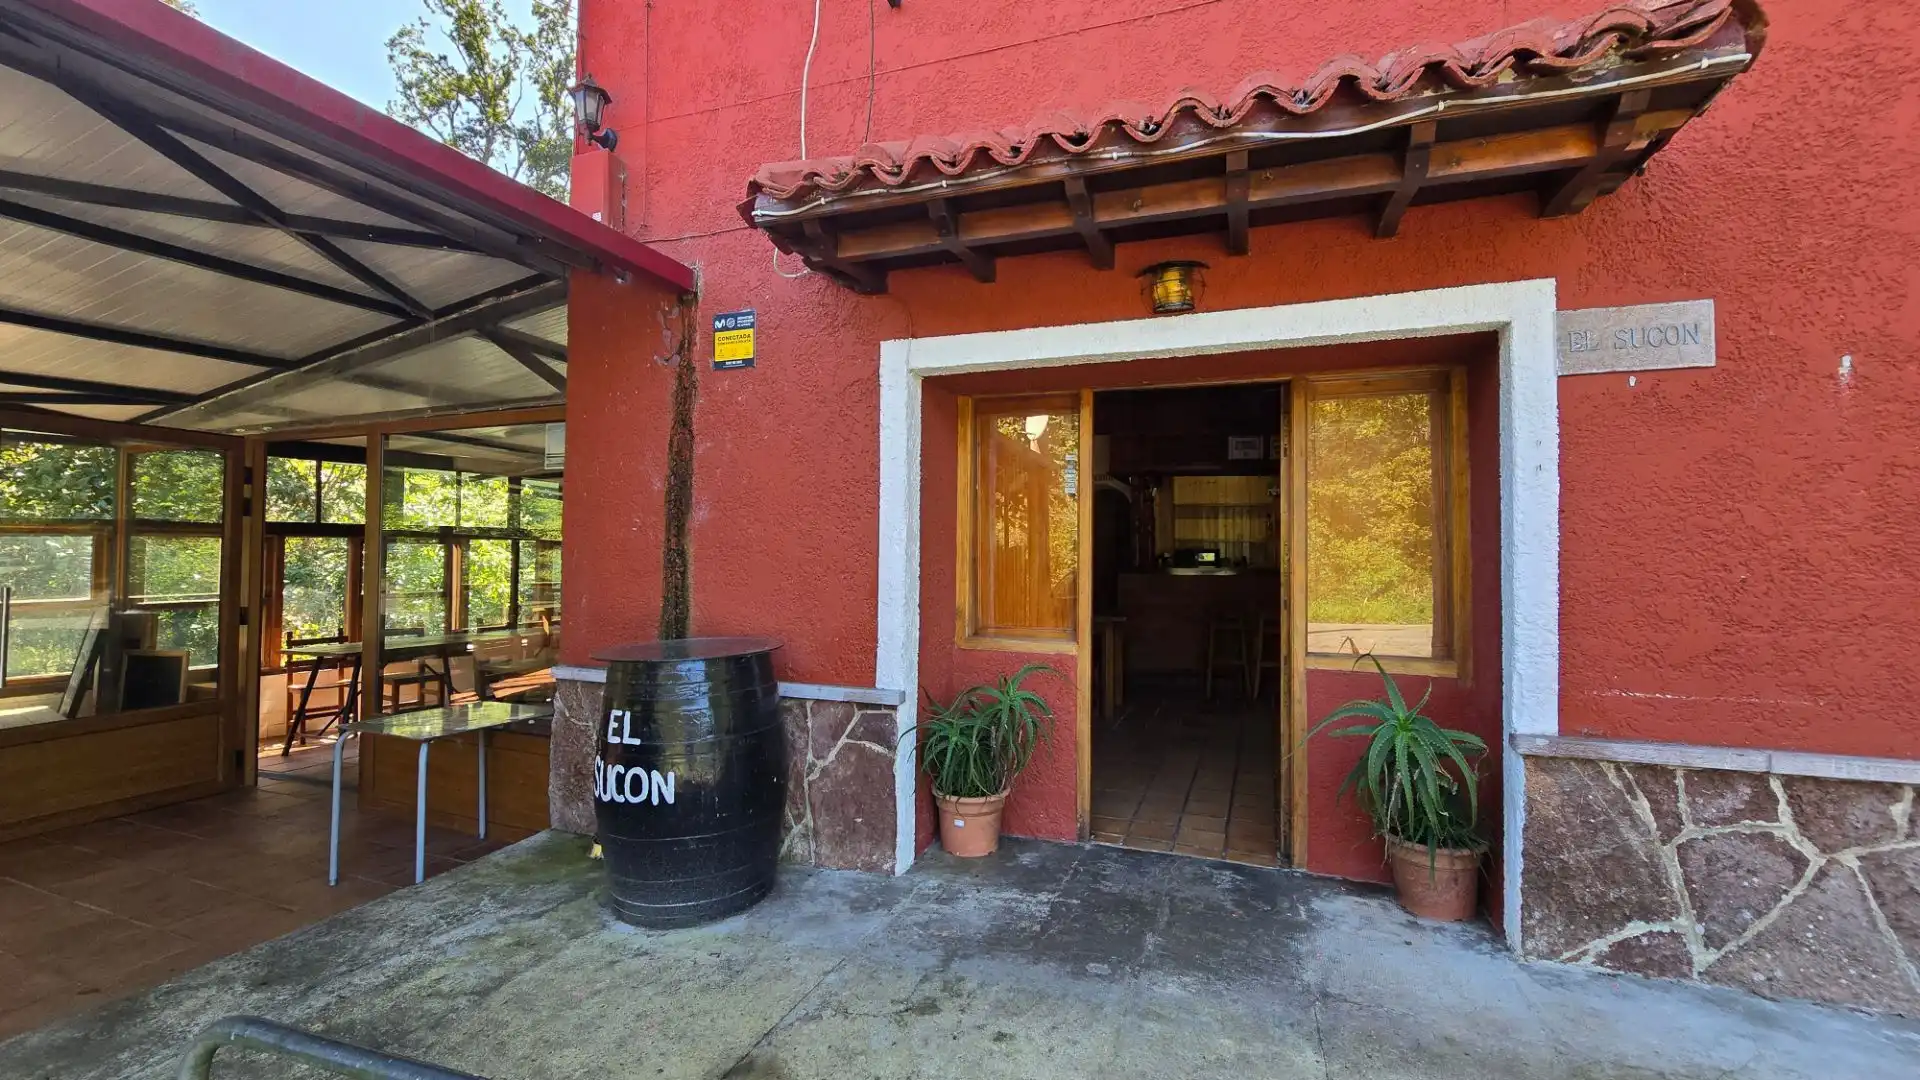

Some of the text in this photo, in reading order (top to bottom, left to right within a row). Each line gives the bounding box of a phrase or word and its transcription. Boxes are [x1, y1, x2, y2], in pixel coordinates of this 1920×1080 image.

[717, 333, 751, 341] CONECTADA
[1568, 323, 1699, 352] EL SUCON
[607, 709, 641, 745] EL
[594, 755, 675, 806] SUCON
